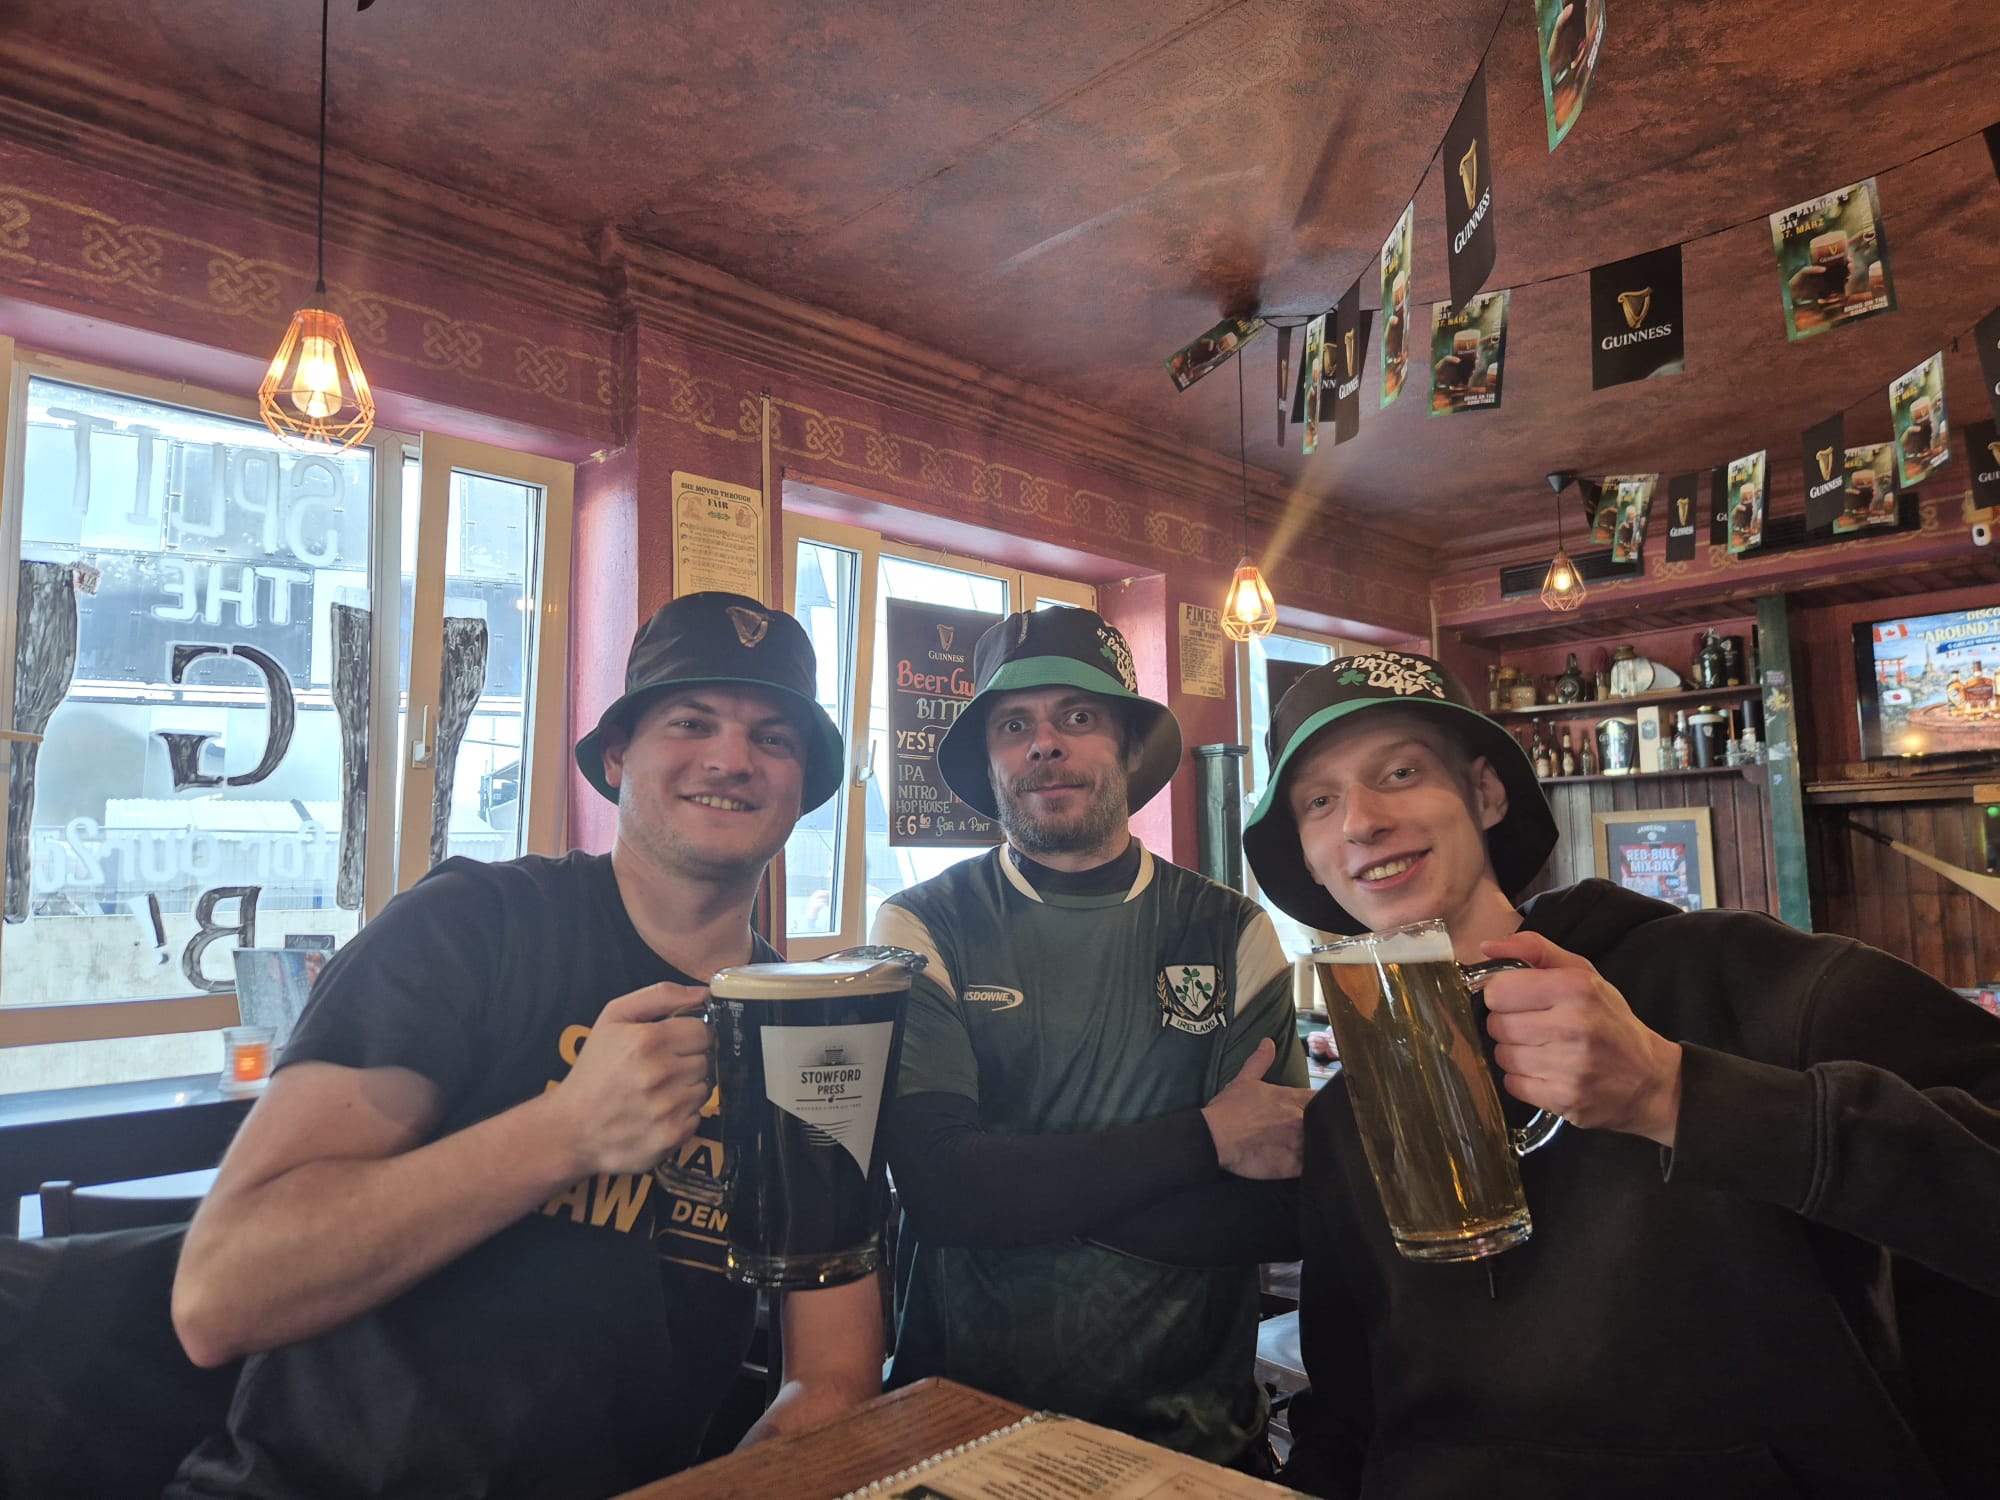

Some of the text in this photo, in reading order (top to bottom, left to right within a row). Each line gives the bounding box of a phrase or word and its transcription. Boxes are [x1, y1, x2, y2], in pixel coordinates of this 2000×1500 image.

[1454, 186, 1490, 254] GUINNESS
[1601, 324, 1672, 350] GUINNESS
[695, 486, 719, 496] MOVED
[720, 490, 751, 503] THROUGH
[1809, 476, 1843, 499] GUINNESS
[707, 498, 729, 510] FAIR
[1186, 605, 1218, 625] FINES
[928, 650, 965, 663] GUINNESS
[896, 659, 949, 694] Beer
[1367, 671, 1423, 695] DAY
[916, 697, 967, 720] BITT
[896, 730, 936, 753] YES!
[897, 764, 925, 781] IPA
[898, 785, 938, 800] NITRO
[1177, 1019, 1216, 1033] IRELAND
[801, 1069, 862, 1084] STOWFORD
[817, 1084, 846, 1096] PRESS
